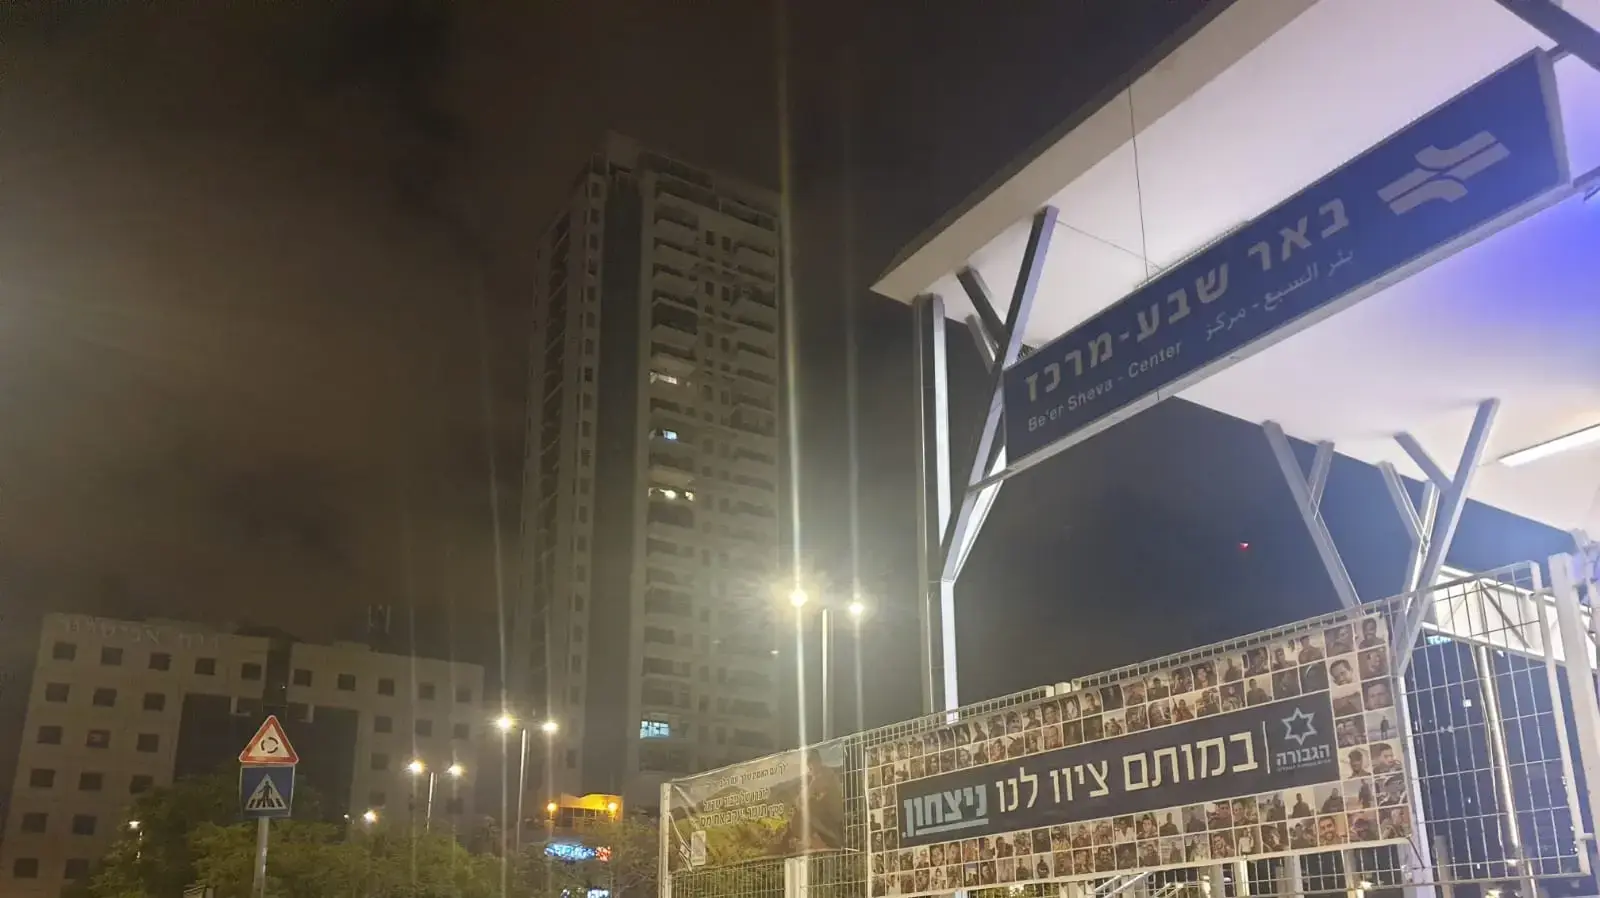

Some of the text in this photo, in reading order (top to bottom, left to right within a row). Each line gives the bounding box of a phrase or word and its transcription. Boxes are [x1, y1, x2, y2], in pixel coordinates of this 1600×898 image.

[1248, 197, 1350, 270] באר
[1328, 249, 1354, 277] بئر
[1263, 264, 1319, 312] السبع
[1204, 306, 1248, 341] مركز
[1027, 404, 1064, 432] Be'er
[1067, 379, 1113, 411] Sheva
[1127, 340, 1182, 380] Center
[1122, 731, 1258, 791] במותם
[1276, 743, 1330, 767] הגבורה
[995, 766, 1040, 812] לנו
[1050, 761, 1110, 802] ציוו
